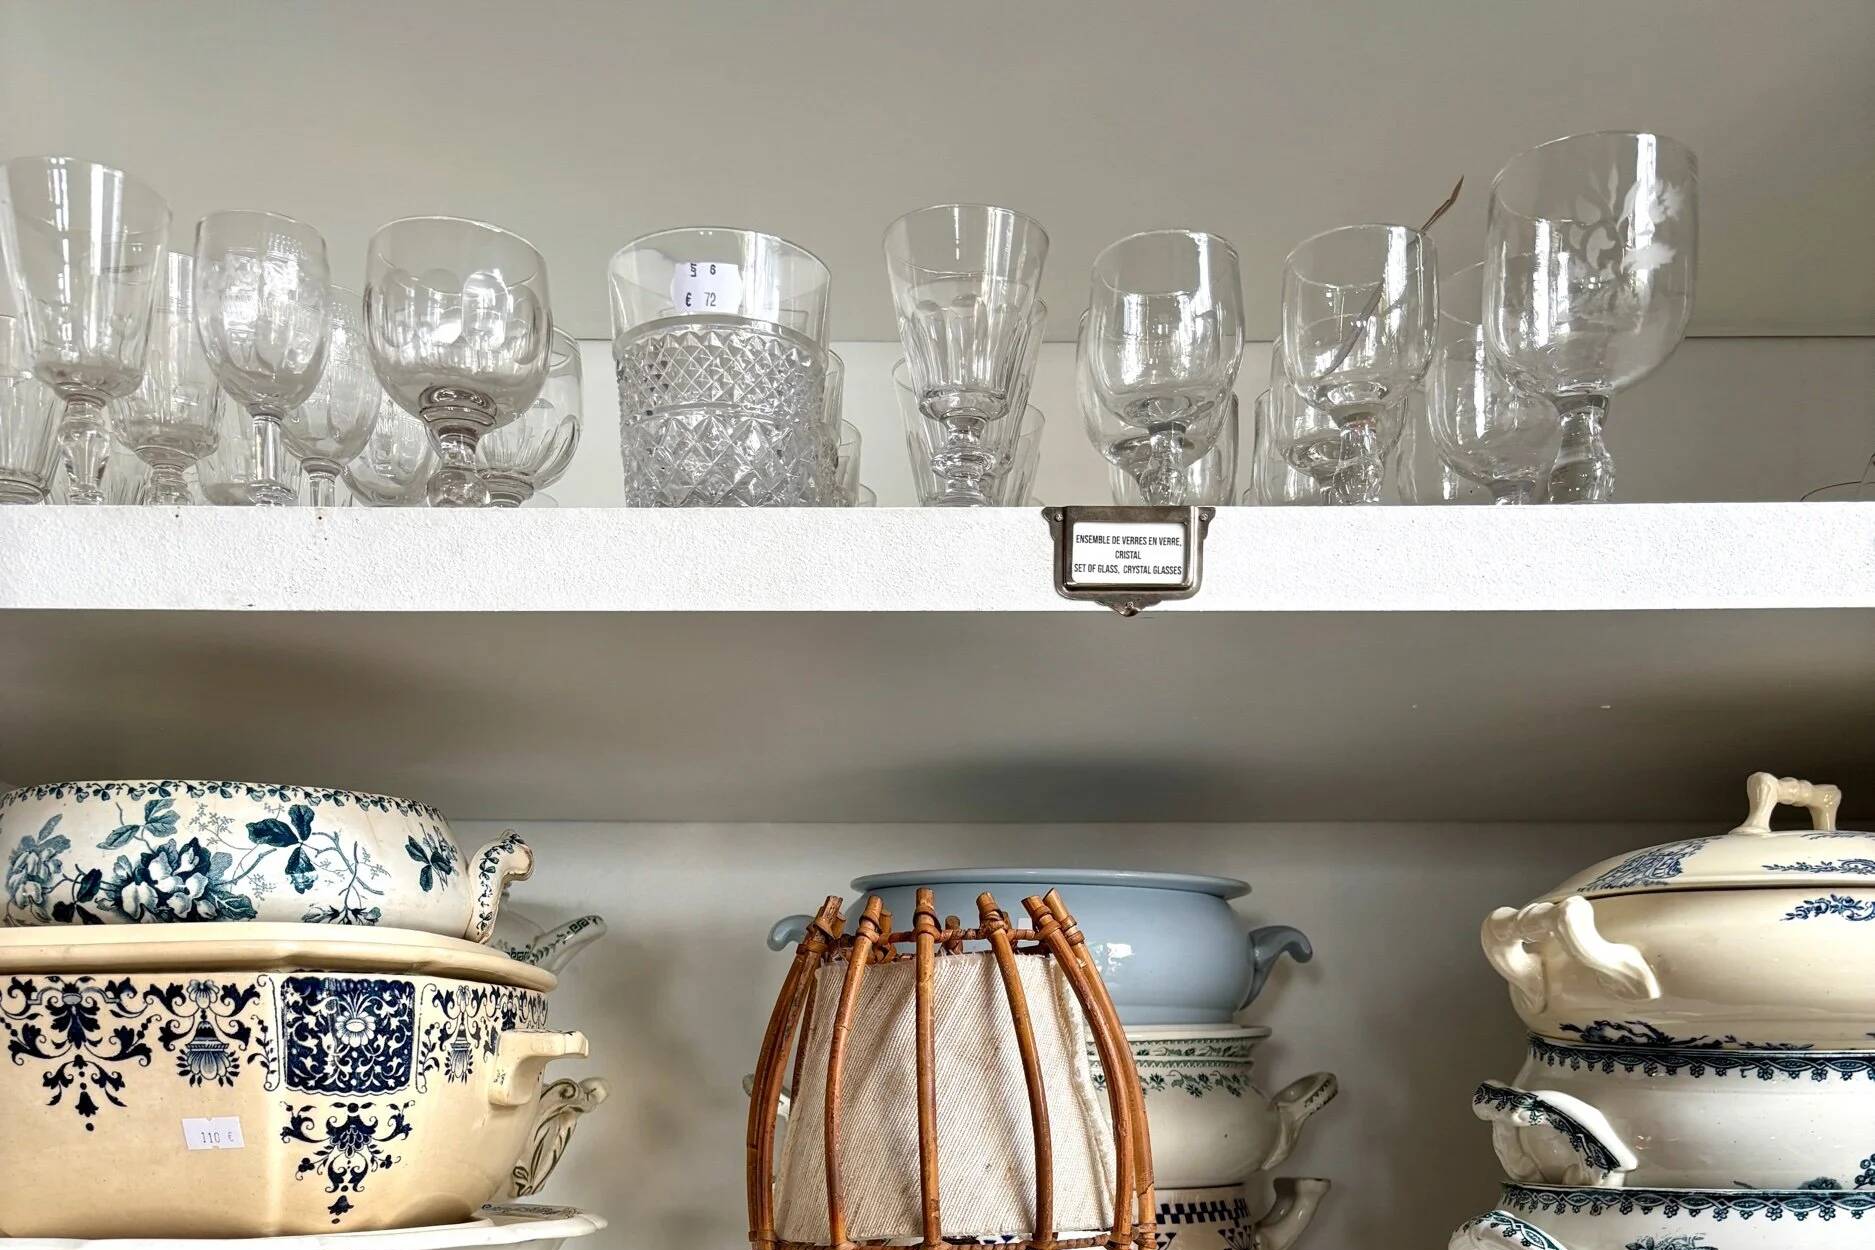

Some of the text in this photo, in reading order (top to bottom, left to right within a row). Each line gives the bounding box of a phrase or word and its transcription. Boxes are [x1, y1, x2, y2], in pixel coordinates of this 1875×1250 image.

[709, 264, 717, 275] 6
[704, 292, 717, 307] 72
[1076, 534, 1182, 548] ENSEMBLE DE VERRES EN VERRE,
[1115, 550, 1142, 560] CRISTAL
[1074, 563, 1182, 576] SET OF GLASS, CRYSTAL GLASSES
[201, 1132, 220, 1143] 110
